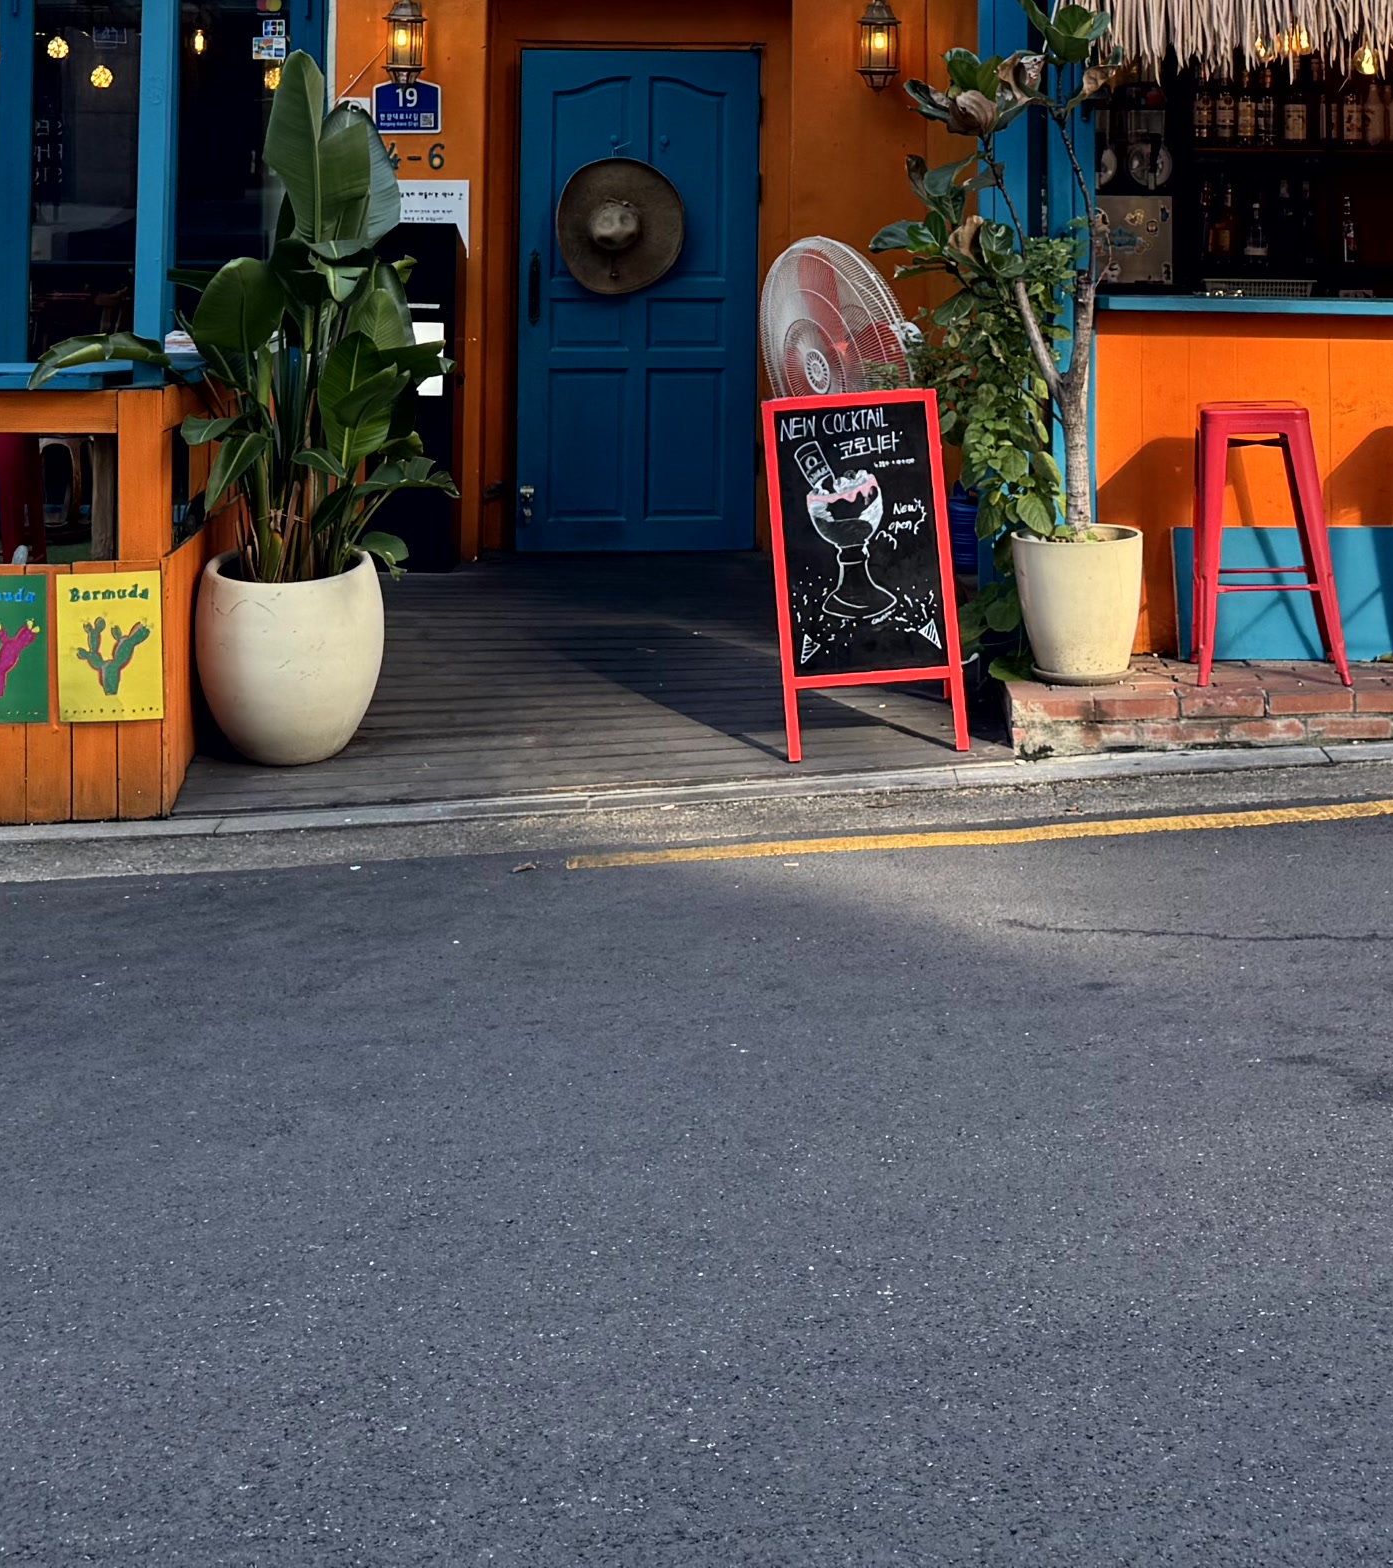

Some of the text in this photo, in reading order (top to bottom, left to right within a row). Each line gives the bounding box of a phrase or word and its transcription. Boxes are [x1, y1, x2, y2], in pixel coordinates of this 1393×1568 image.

[395, 87, 418, 108] 19
[780, 415, 816, 442] NEW
[888, 520, 912, 534] open
[69, 584, 149, 603] Bermuda
